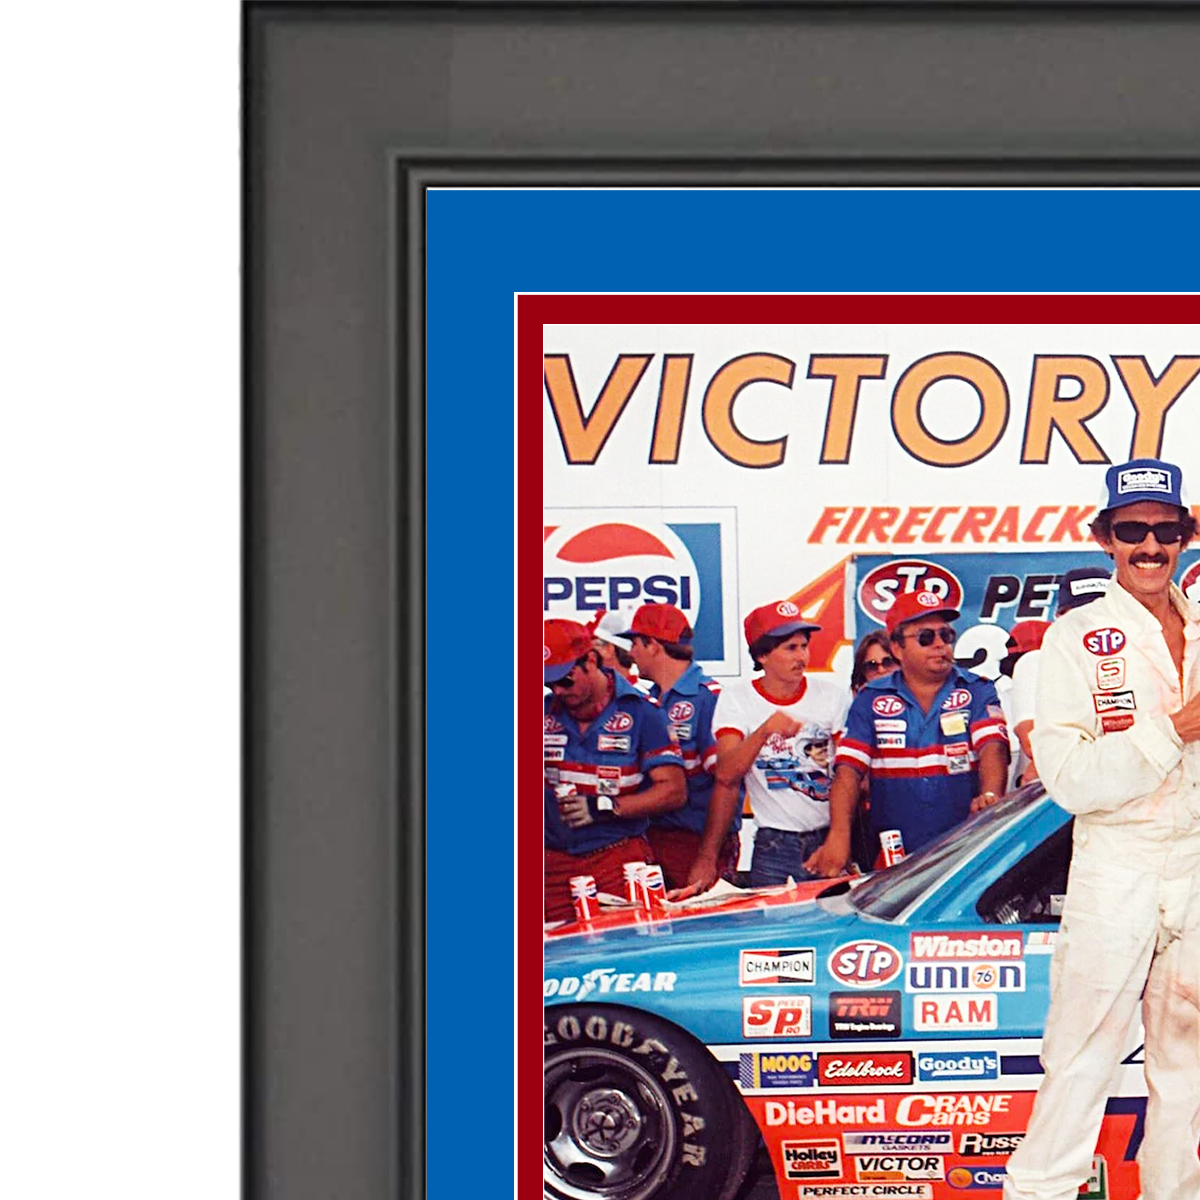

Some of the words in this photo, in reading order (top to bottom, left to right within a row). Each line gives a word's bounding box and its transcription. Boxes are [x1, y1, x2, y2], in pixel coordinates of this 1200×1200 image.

[807, 505, 1097, 544] FIRECRACK
[544, 575, 691, 611] PEPSI
[1087, 629, 1124, 653] STP
[876, 698, 902, 713] STP
[913, 934, 1021, 958] Winston
[746, 960, 810, 973] CHAMPION
[837, 944, 893, 978] STP
[544, 968, 677, 1000] ODYEAR
[976, 970, 992, 983] 76
[835, 997, 893, 1018] TRW
[921, 1000, 991, 1024] RAM
[761, 1054, 812, 1073] MOOG
[824, 1059, 904, 1079] Edelbrock
[919, 1056, 997, 1074] Goody's
[765, 1099, 886, 1126] DieHard
[785, 1149, 837, 1164] Holley
[791, 1160, 831, 1170] CARBS
[859, 1157, 940, 1171] VICTOR
[803, 1186, 871, 1196] PERFECT
[872, 1185, 926, 1195] CIRCLE
